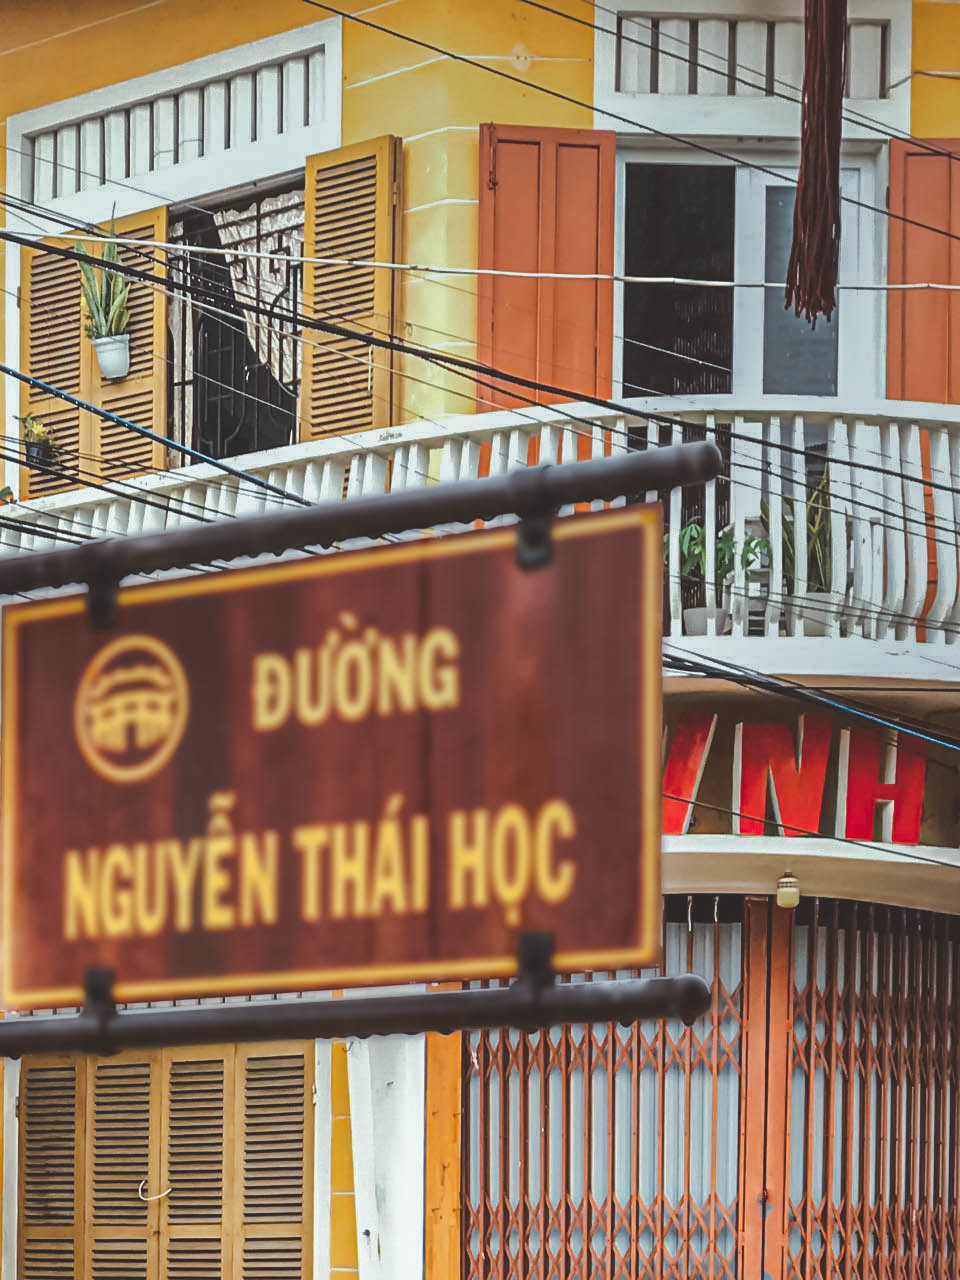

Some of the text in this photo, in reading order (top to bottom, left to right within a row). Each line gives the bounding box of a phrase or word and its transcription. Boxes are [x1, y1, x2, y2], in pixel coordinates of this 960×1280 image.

[252, 612, 459, 732] ĐƯỜNG
[64, 792, 577, 939] NGUYỄN THÁI HỌC
